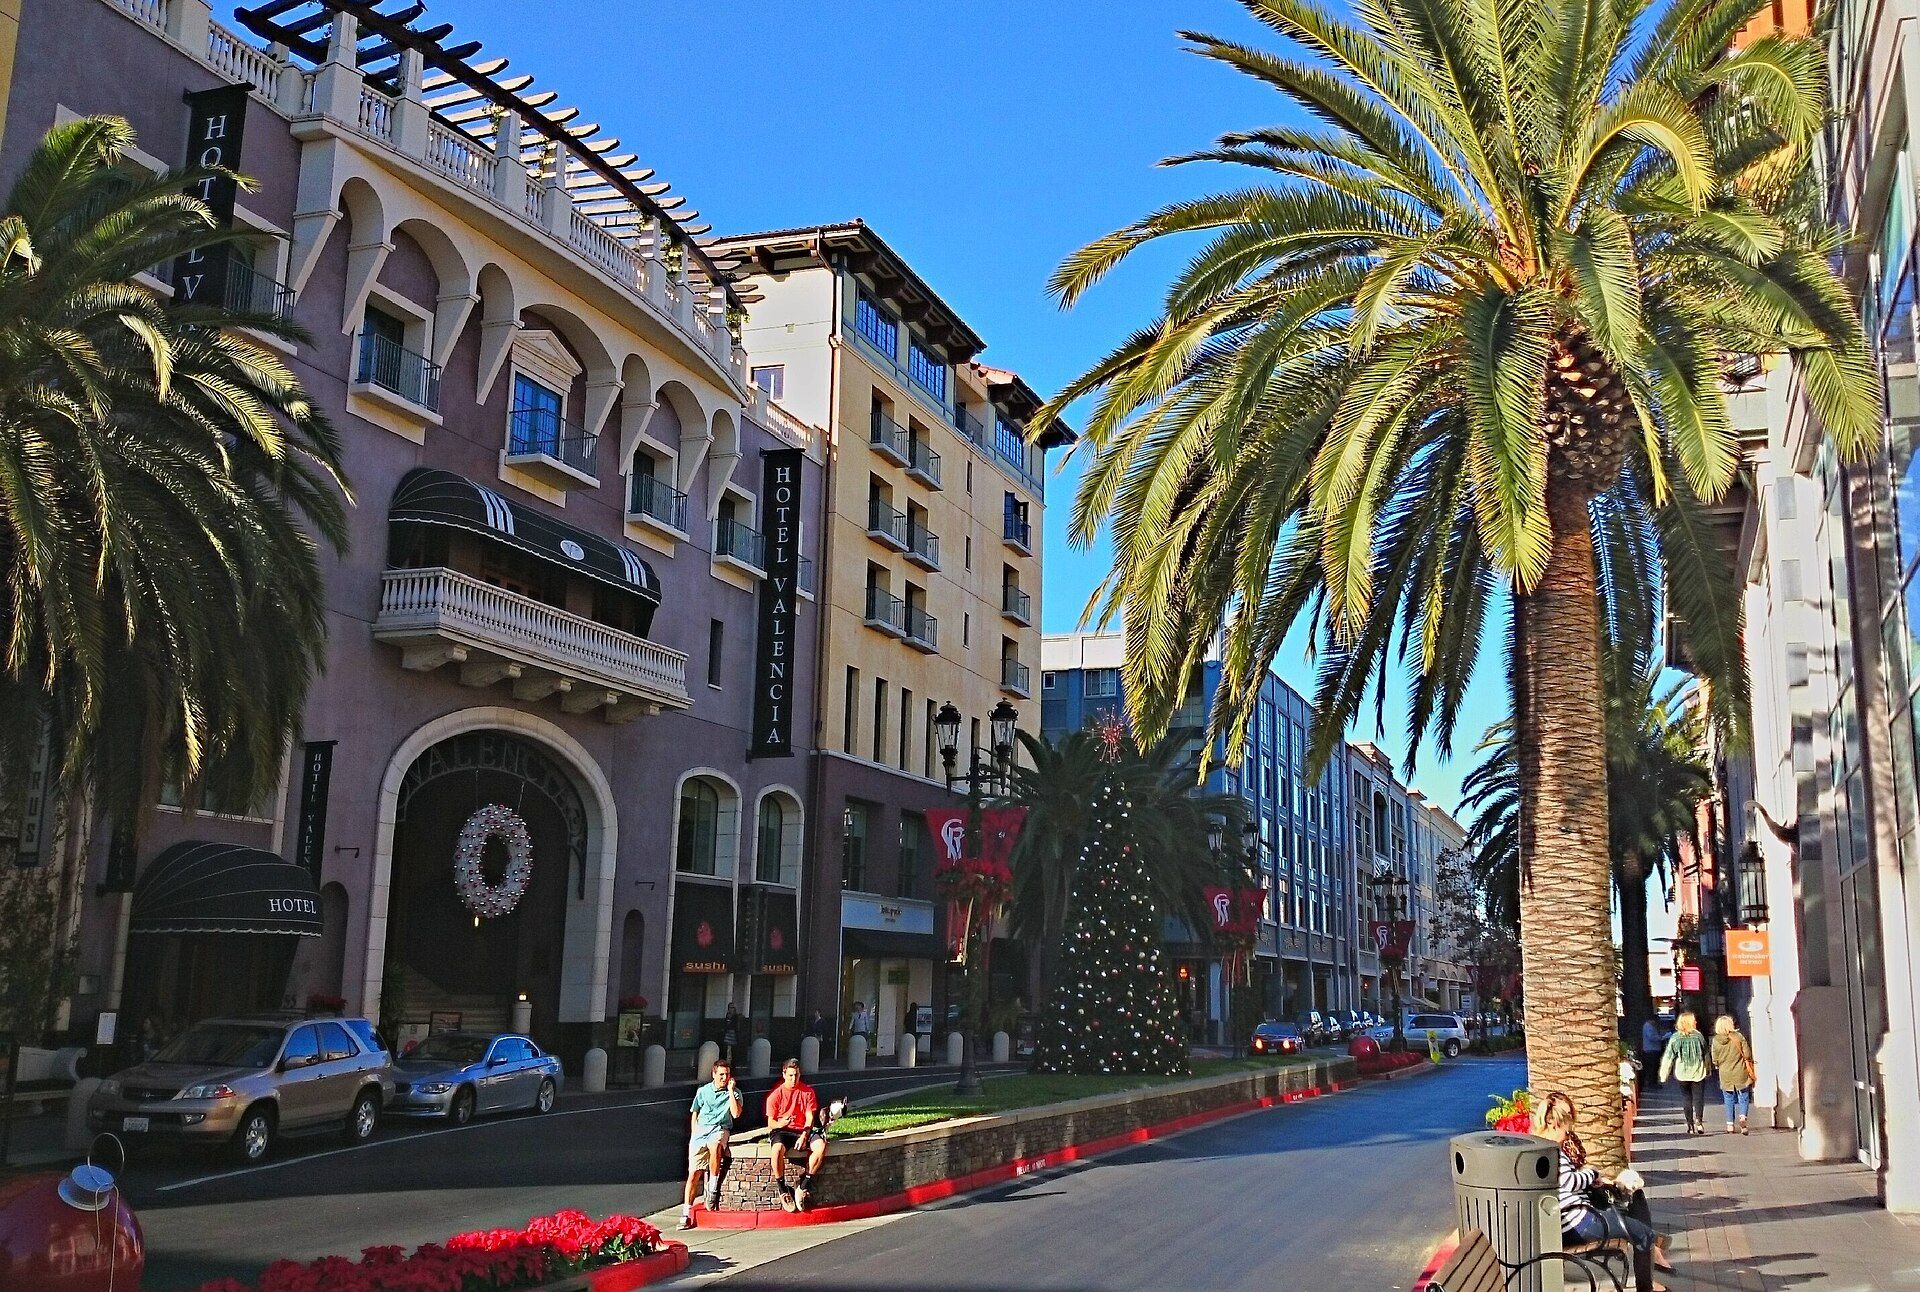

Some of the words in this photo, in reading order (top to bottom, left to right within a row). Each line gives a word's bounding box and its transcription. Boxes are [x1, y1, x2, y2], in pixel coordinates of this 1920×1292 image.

[188, 115, 228, 265] HOTL
[775, 466, 791, 563] HOTEL
[766, 577, 788, 744] VALENCIA
[310, 753, 322, 802] HOTEL
[269, 898, 317, 914] HOTEL
[686, 961, 726, 971] sushi
[762, 964, 795, 973] sushi
